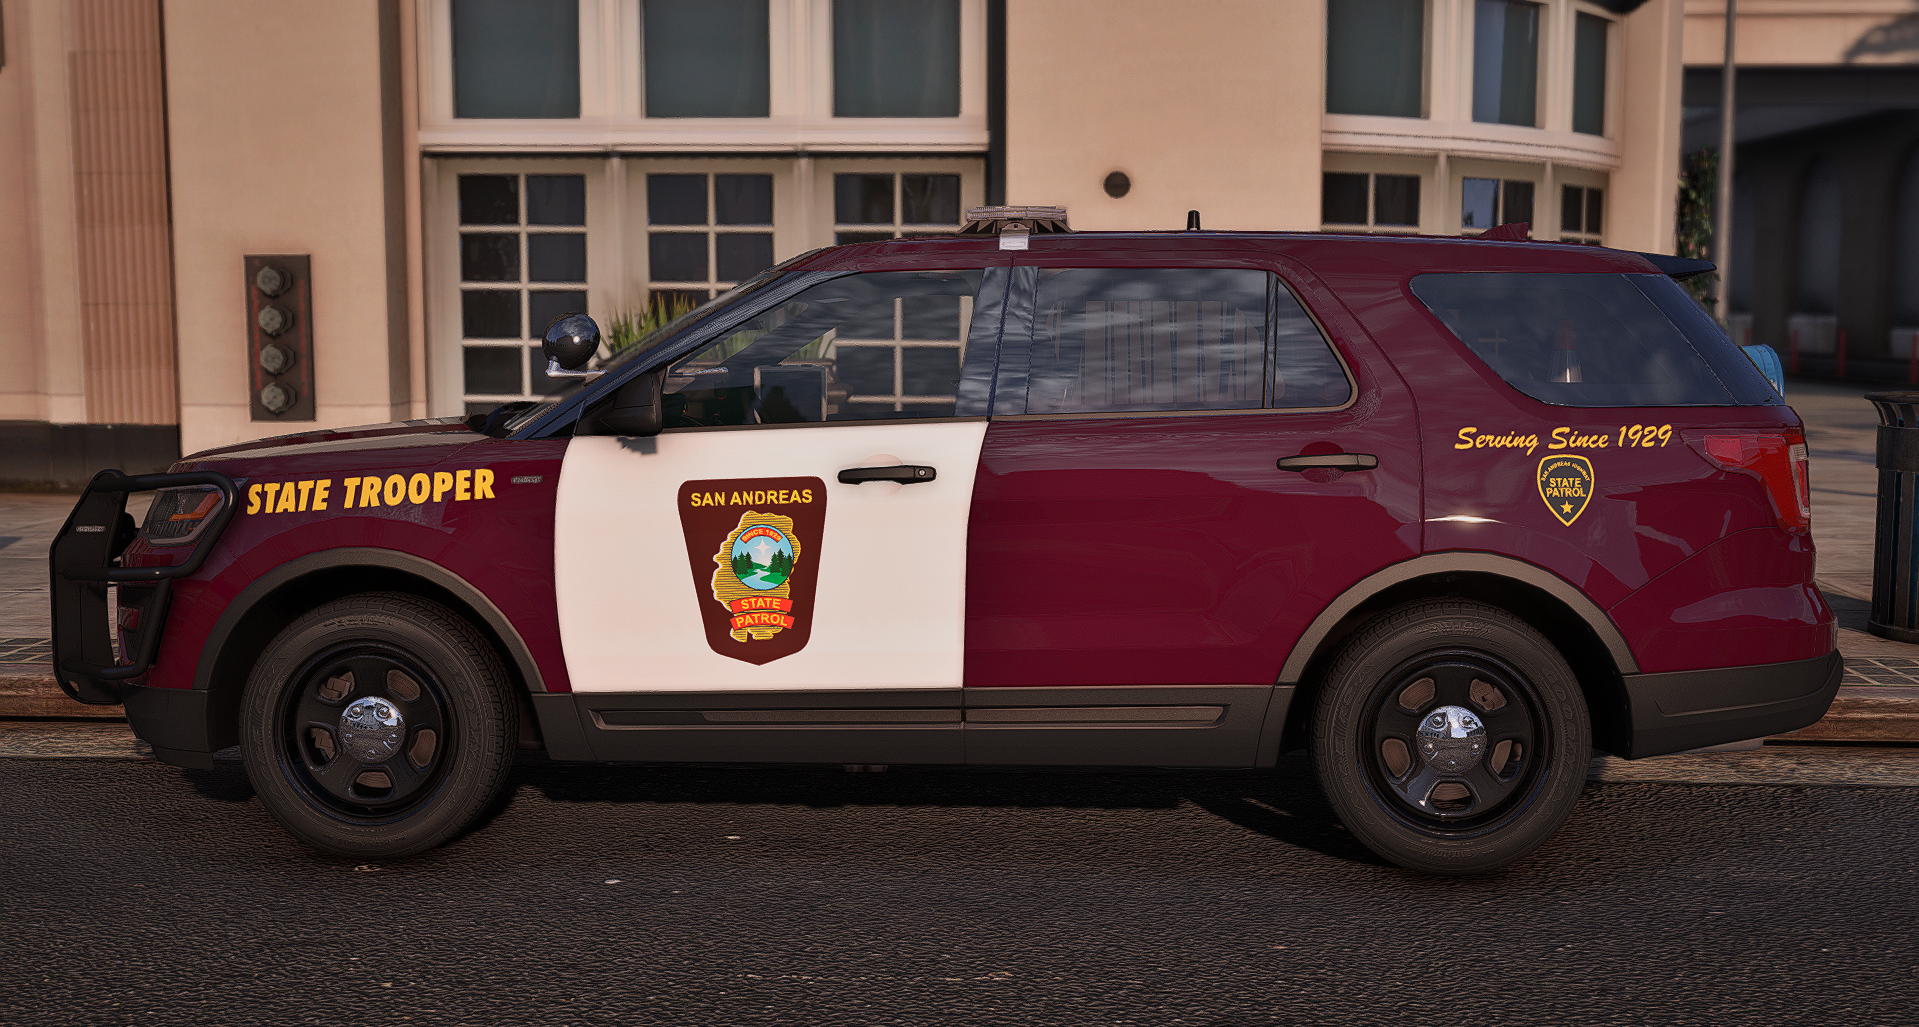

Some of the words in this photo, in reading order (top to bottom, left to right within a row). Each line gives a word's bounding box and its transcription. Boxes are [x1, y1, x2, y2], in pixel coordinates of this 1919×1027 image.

[1454, 426, 1540, 456] Serving
[1547, 426, 1610, 450] Since
[1617, 423, 1673, 449] 1929
[1549, 477, 1582, 488] STATE
[246, 478, 332, 515] STATE
[343, 468, 496, 510] TROOPER
[690, 491, 726, 508] SAN
[729, 488, 813, 506] ANDREAS
[1546, 487, 1587, 498] PATROL
[742, 528, 764, 542] SINCE
[740, 597, 782, 610] STATE
[735, 613, 788, 628] PATROL
